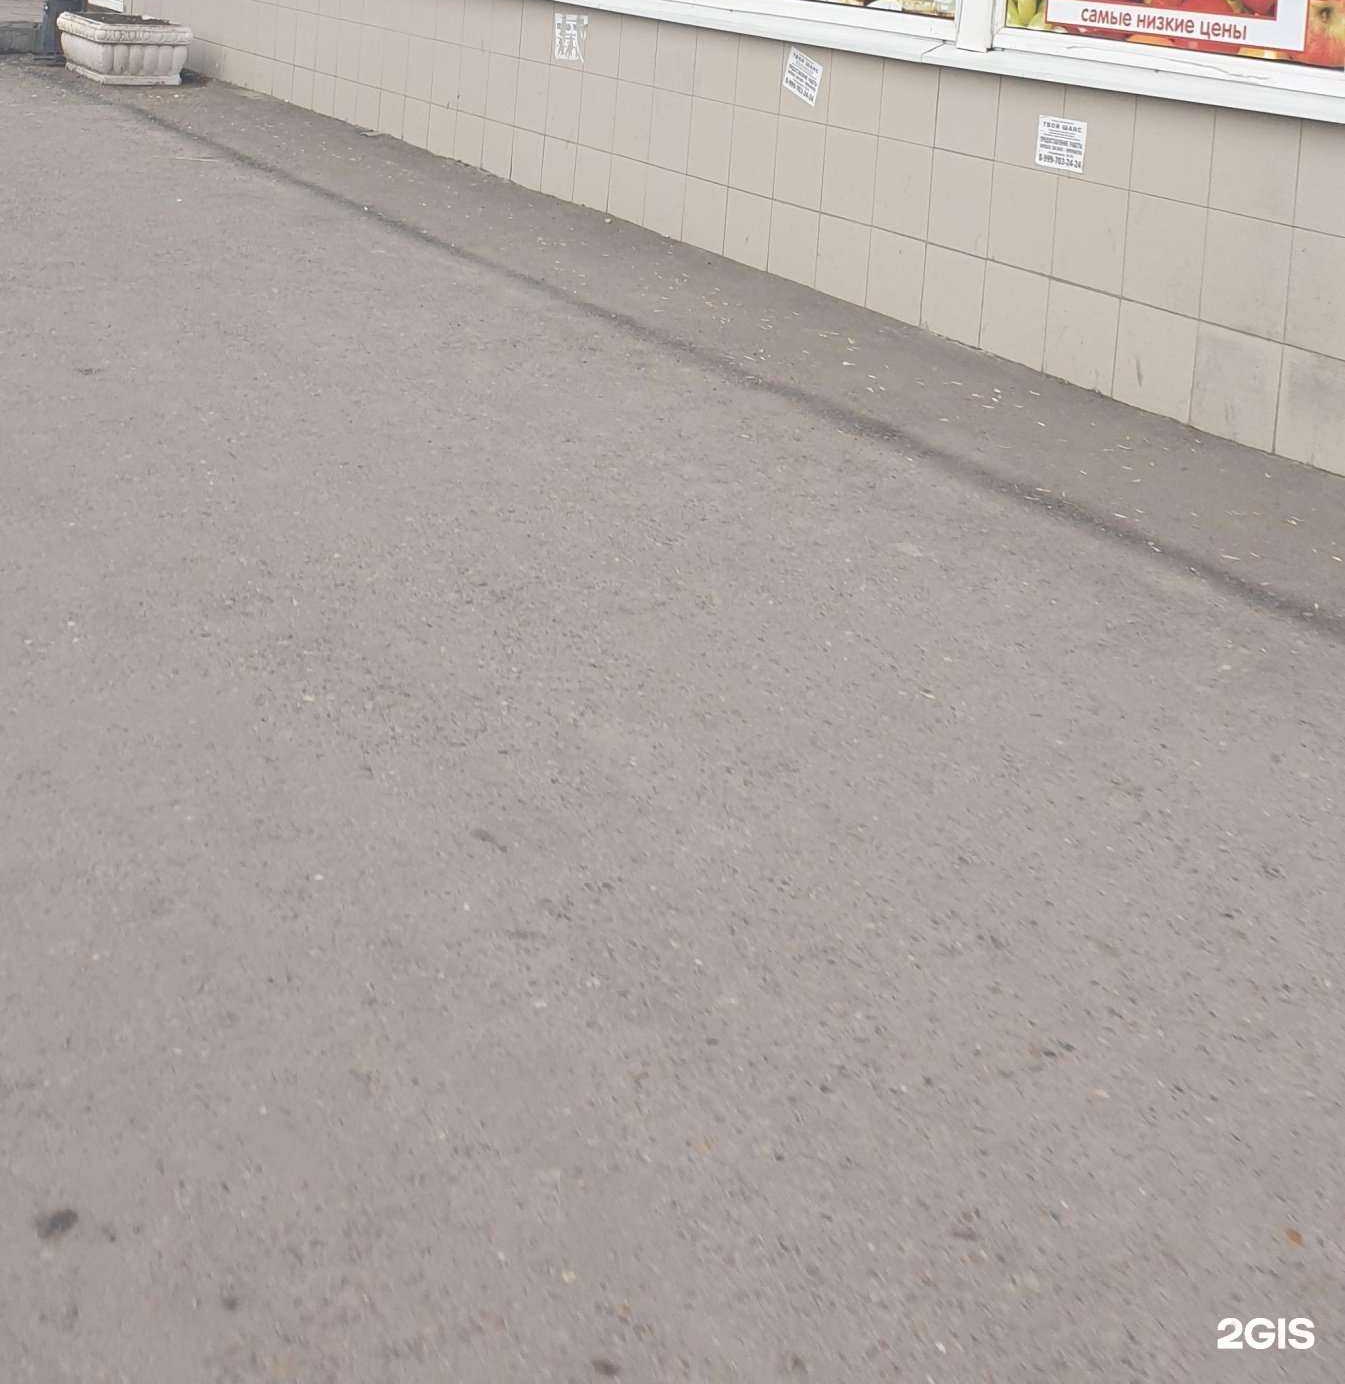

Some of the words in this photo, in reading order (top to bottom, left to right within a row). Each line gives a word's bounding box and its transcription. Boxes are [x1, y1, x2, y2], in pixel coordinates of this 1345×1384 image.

[1080, 7, 1132, 27] самые
[1136, 14, 1195, 34] низкие
[1199, 22, 1248, 41] цены
